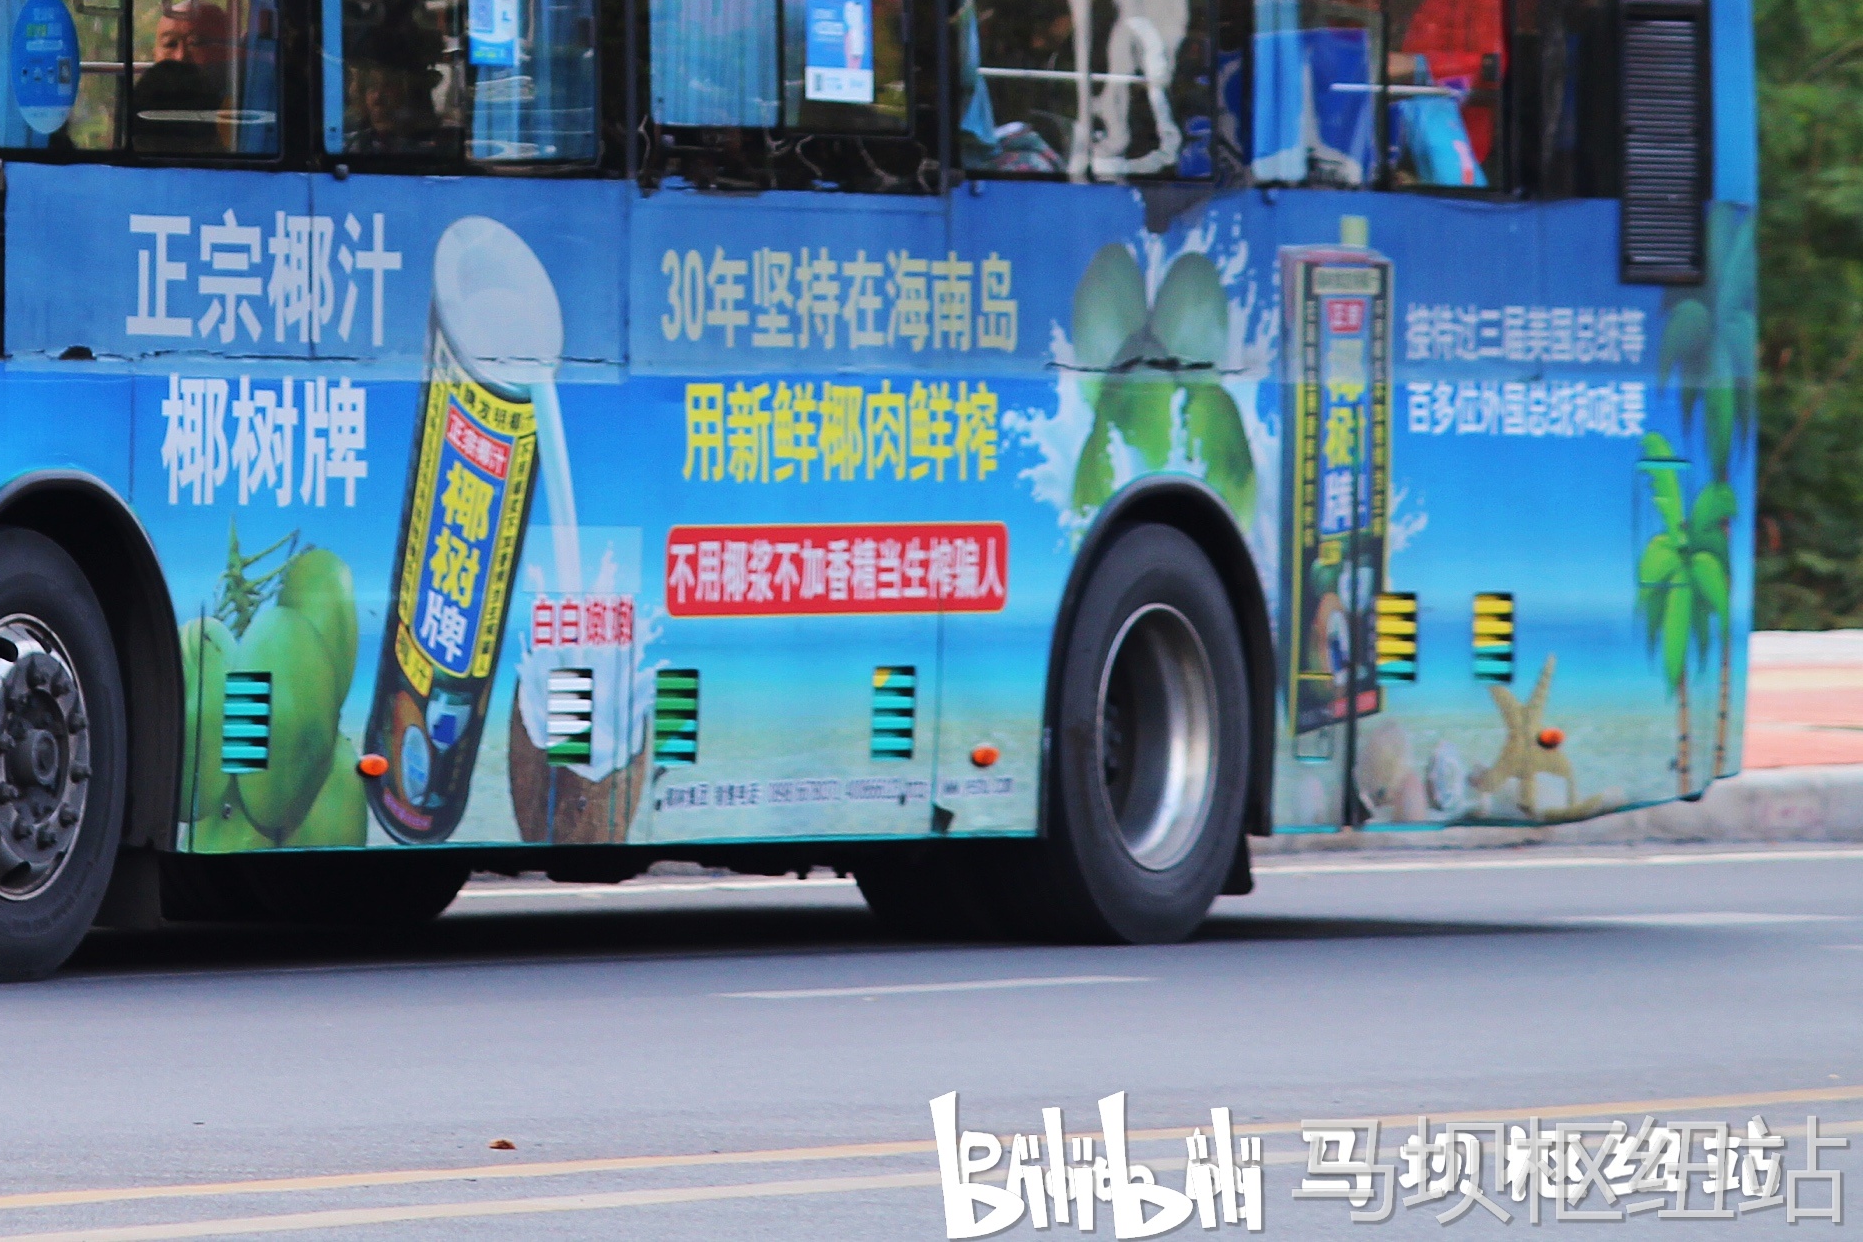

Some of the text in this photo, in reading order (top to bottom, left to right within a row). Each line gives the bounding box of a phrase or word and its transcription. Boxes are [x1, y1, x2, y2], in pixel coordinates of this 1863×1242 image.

[126, 209, 402, 347] 正宗椰汁
[660, 247, 1019, 353] 30年坚持在海南岛
[161, 374, 368, 507] 椰树牌
[683, 380, 999, 482] 用新鲜椰肉鲜榨
[420, 460, 496, 664] 椰树牌
